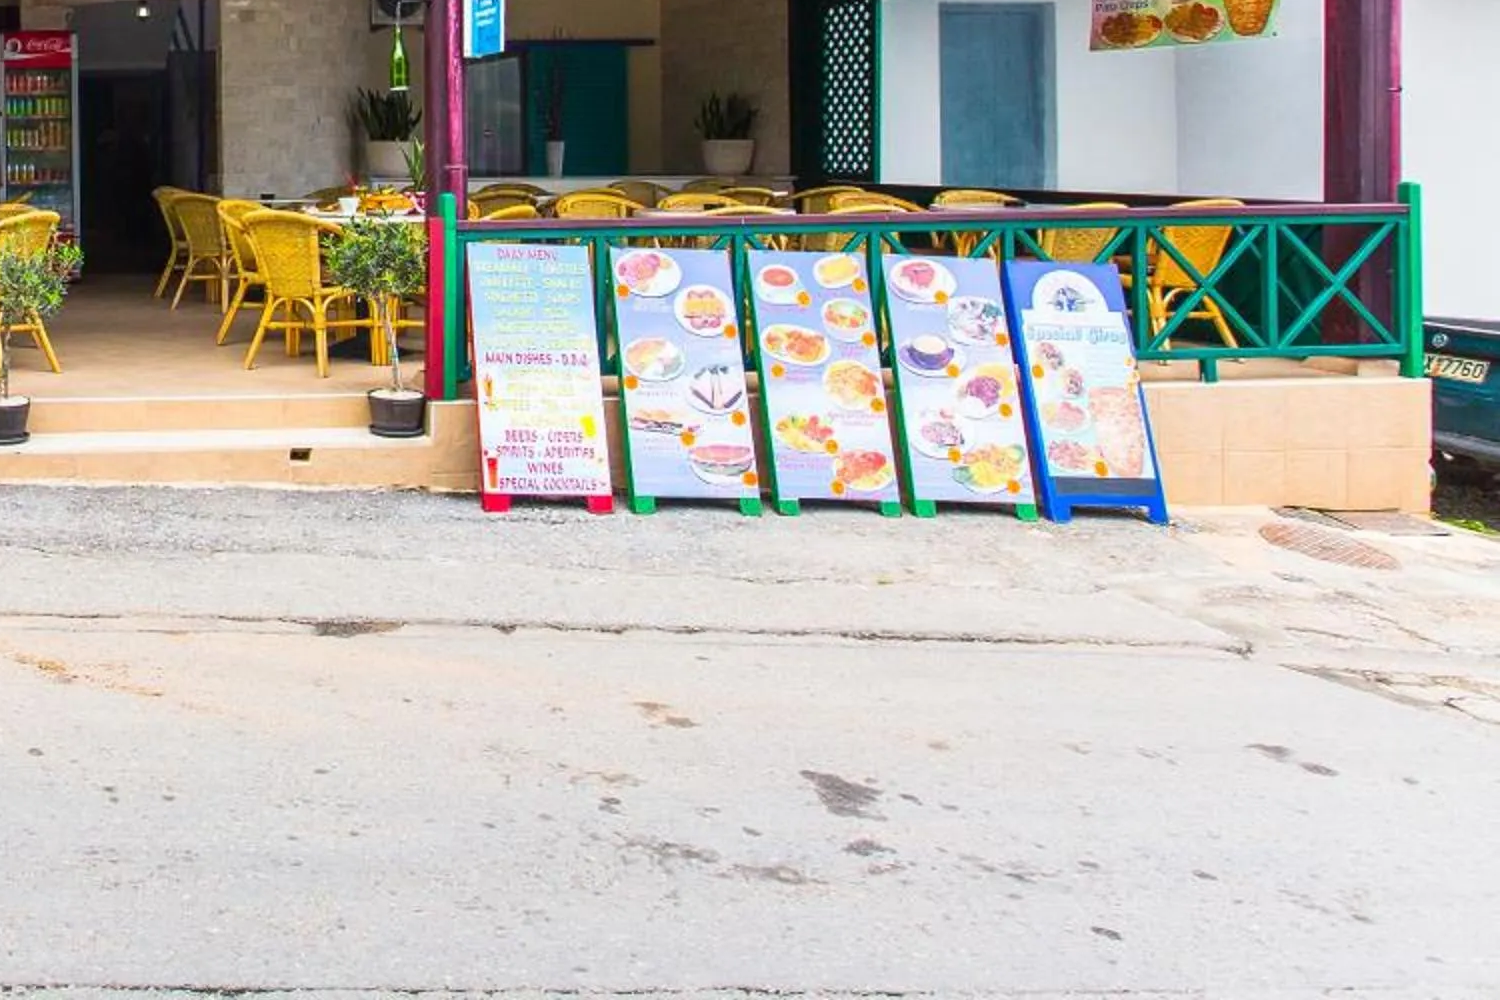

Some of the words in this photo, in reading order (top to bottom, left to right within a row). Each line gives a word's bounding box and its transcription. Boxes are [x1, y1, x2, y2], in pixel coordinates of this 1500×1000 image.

[485, 352, 513, 364] MAIN
[515, 353, 553, 365] DISHES
[504, 429, 538, 442] BEERS
[547, 430, 584, 443] CIDERS
[496, 445, 535, 458] SPIRITS
[527, 461, 564, 475] WINES
[500, 477, 540, 491] SPECIAL
[542, 478, 597, 491] COCKTAILS
